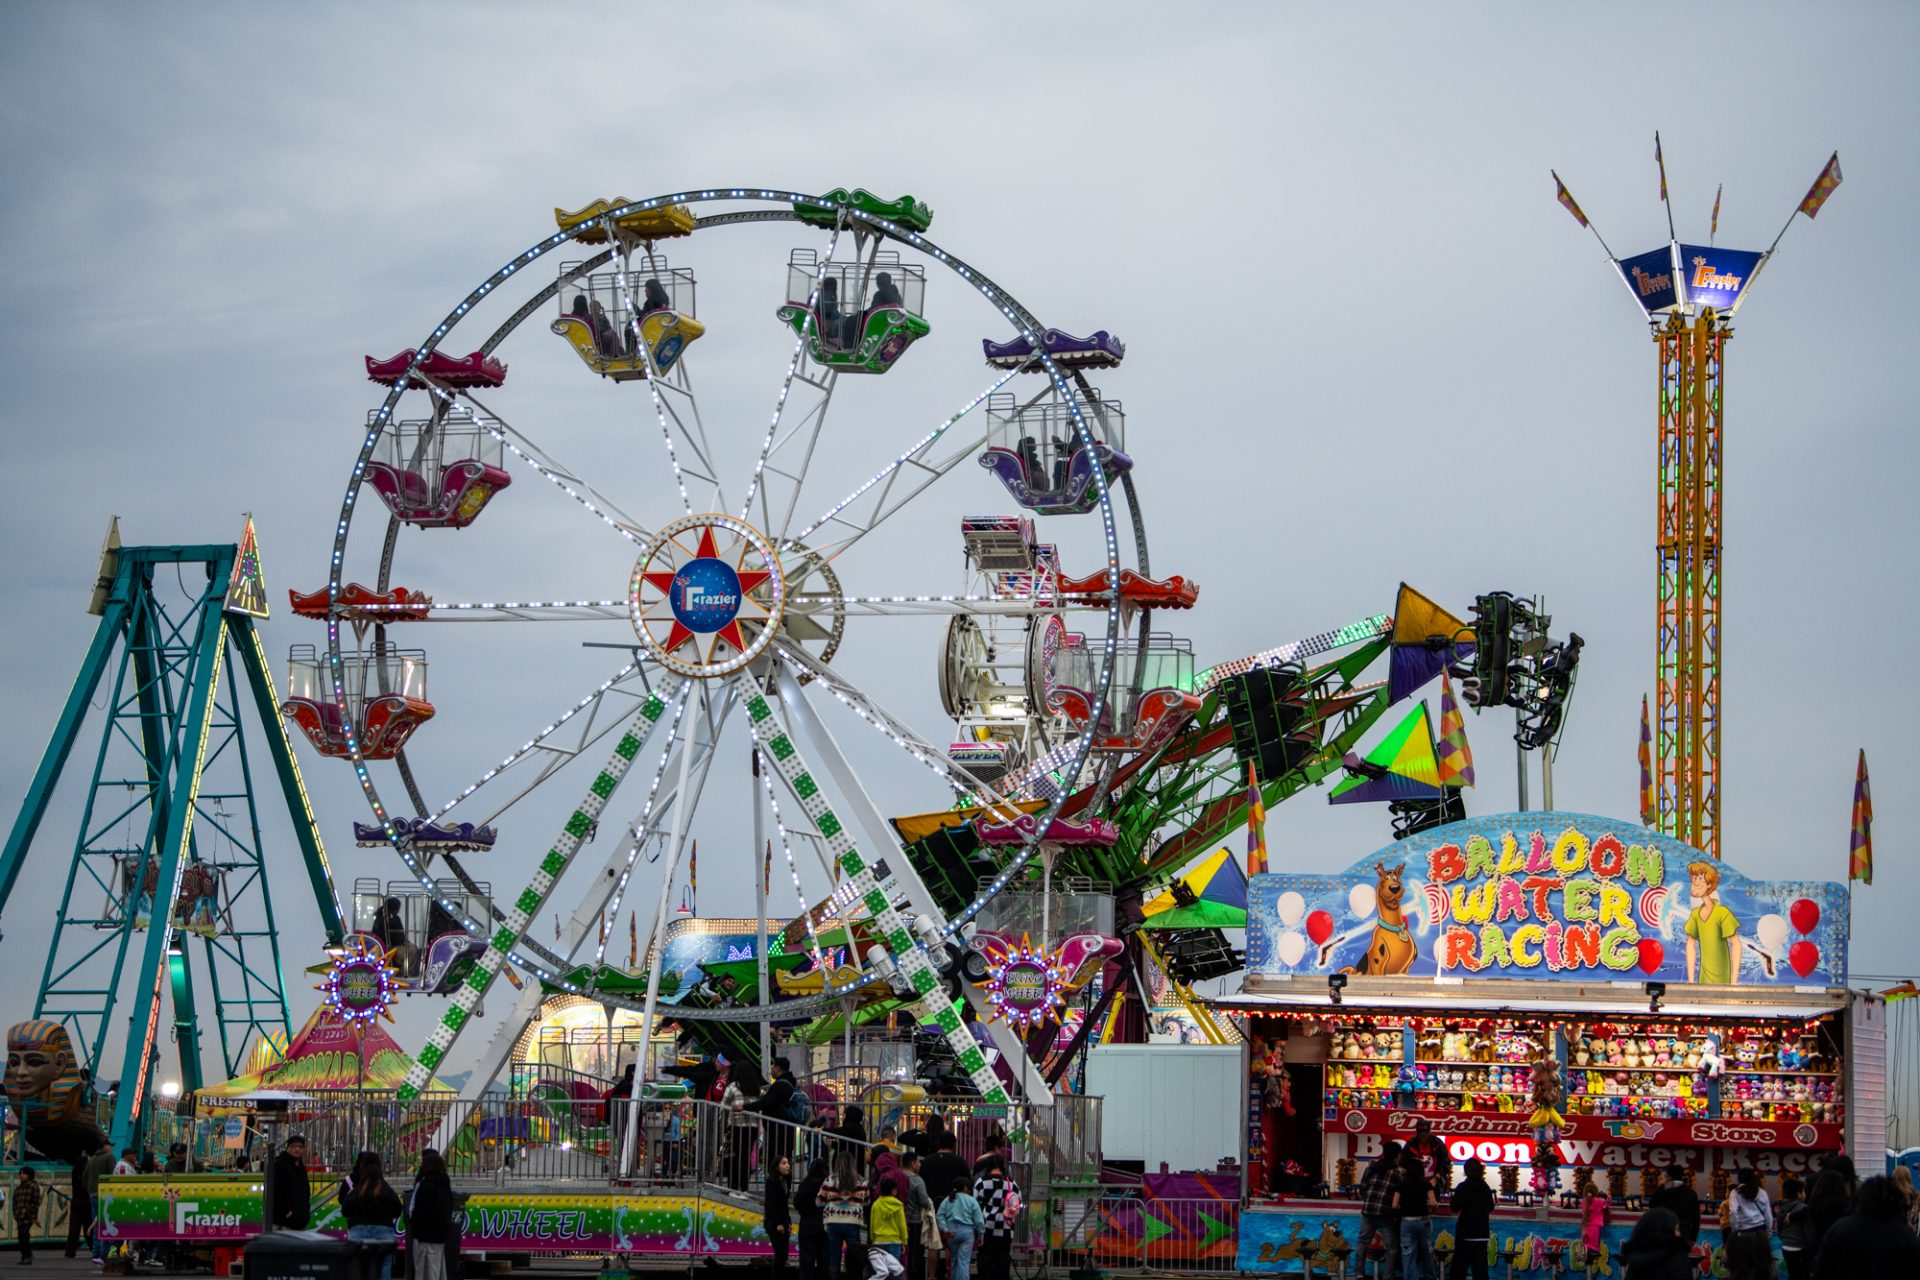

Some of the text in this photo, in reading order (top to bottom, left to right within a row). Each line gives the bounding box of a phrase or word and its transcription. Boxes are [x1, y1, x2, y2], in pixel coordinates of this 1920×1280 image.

[1699, 265, 1742, 288] Frazier
[686, 587, 737, 611] Frazier
[1427, 826, 1664, 888] BALLOON
[1450, 873, 1636, 930] WATER
[1445, 920, 1642, 972] RACING
[1005, 971, 1046, 984] EURO
[1002, 986, 1047, 1000] WHEEL
[973, 1107, 1006, 1117] ENTER
[1691, 1122, 1777, 1143] Store
[1558, 1140, 1697, 1169] Water
[176, 1202, 242, 1234] Frazier
[480, 1208, 593, 1240] WHEEL
